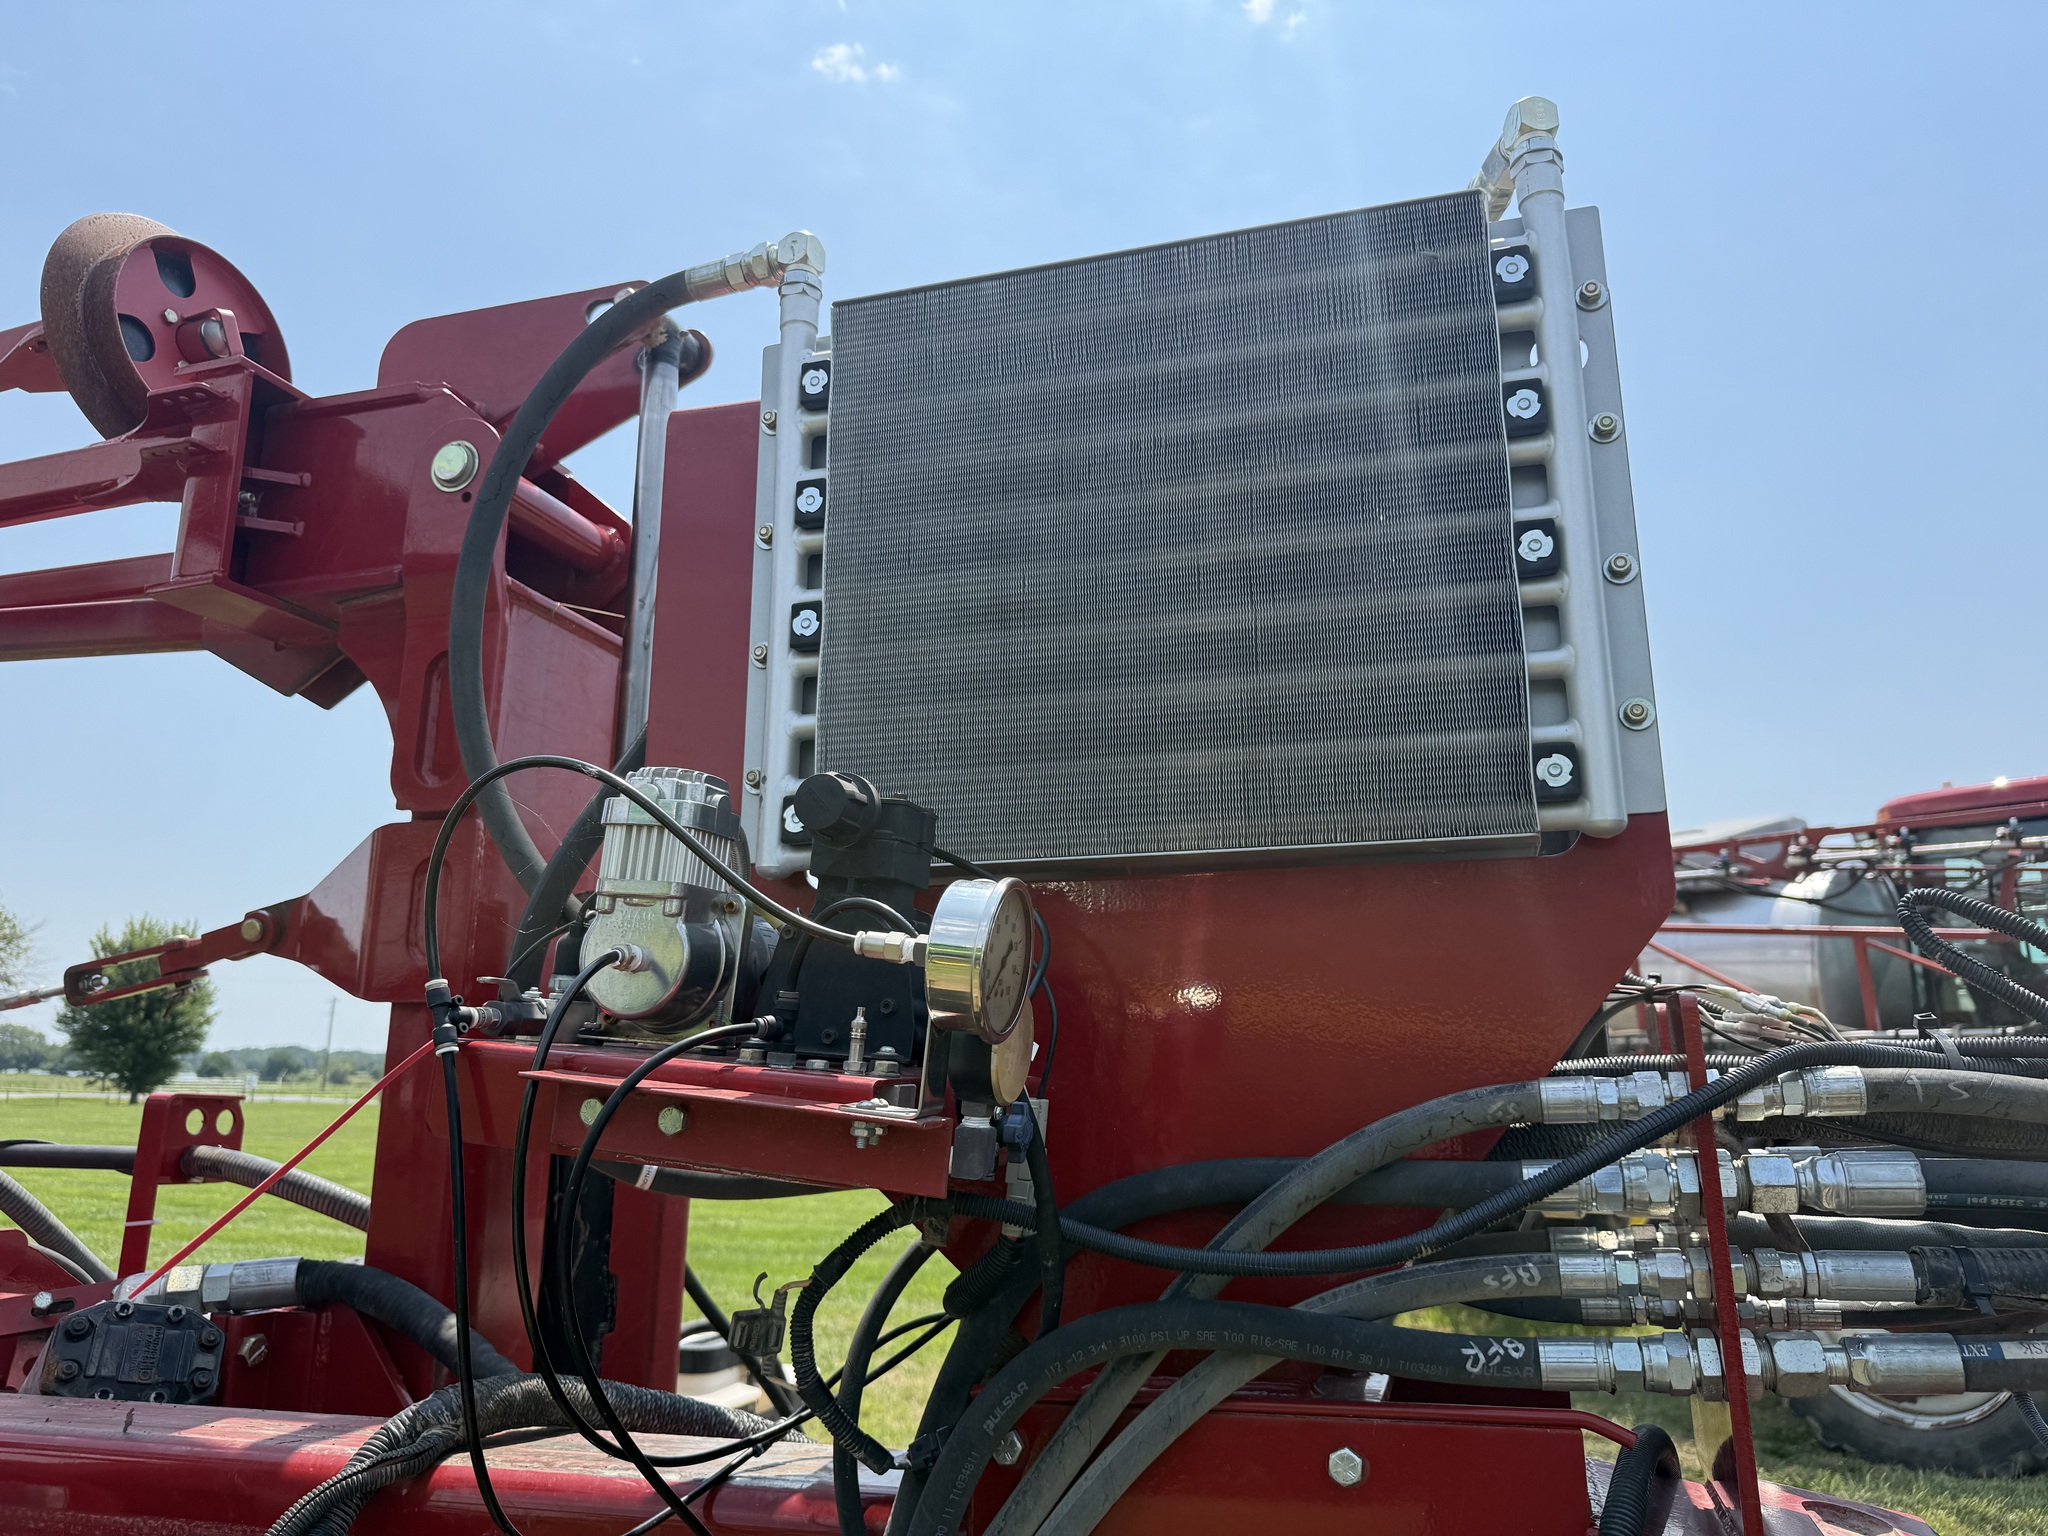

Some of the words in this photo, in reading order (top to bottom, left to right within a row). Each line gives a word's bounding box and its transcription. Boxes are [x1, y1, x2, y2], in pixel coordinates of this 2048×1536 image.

[1966, 1196, 1988, 1206] psi
[1990, 1198, 2025, 1207] 3125
[1118, 1332, 1147, 1348] 3100
[1150, 1330, 1171, 1342] PSI
[1196, 1330, 1218, 1342] SAE
[1223, 1330, 1246, 1344] 100
[1250, 1334, 1299, 1351] R16/SAE
[1305, 1343, 1327, 1357] 100
[982, 1380, 1030, 1437] PULSAR
[949, 1450, 981, 1501] T1034811
